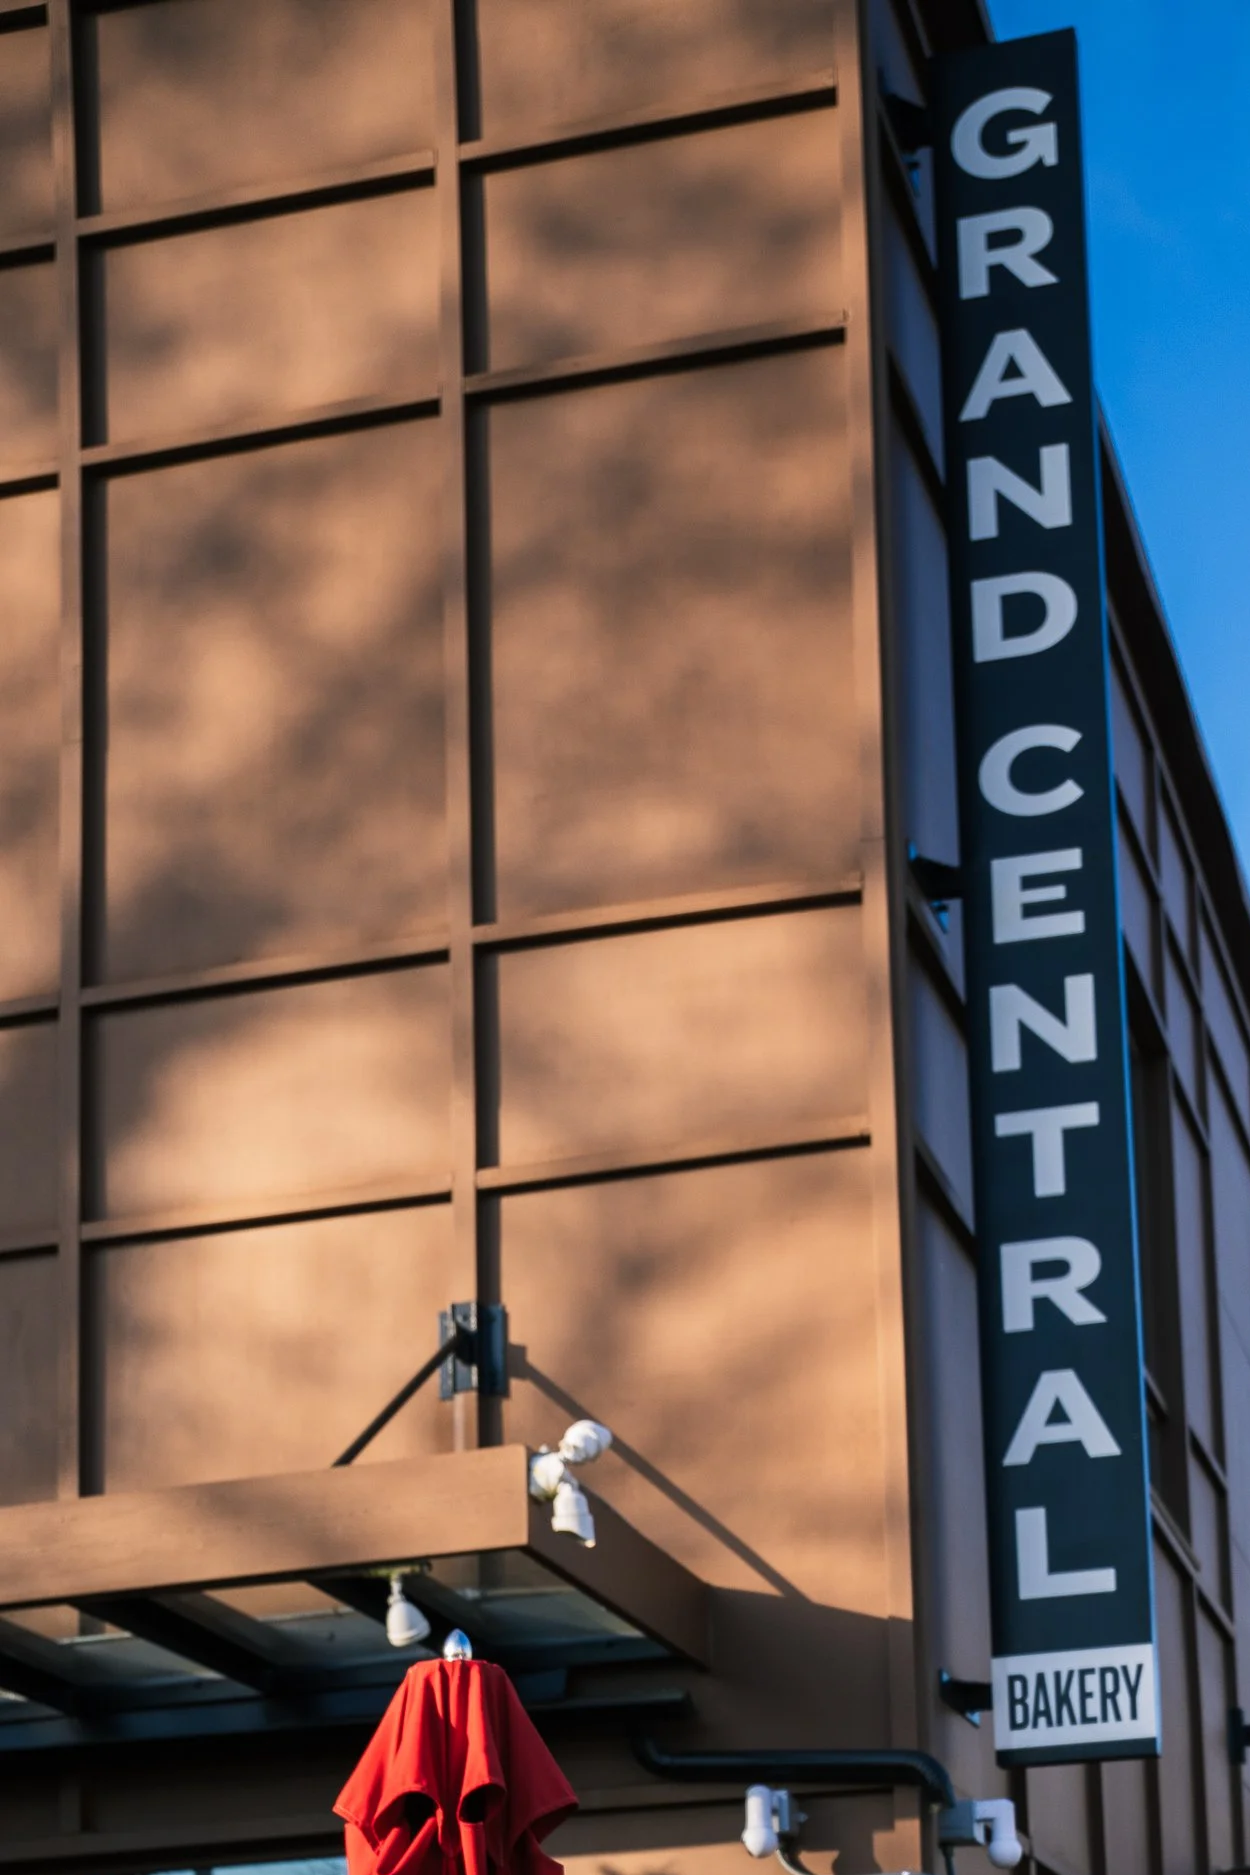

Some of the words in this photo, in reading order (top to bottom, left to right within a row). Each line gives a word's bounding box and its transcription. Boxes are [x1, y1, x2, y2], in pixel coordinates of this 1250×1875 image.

[950, 86, 1078, 663] GRAND
[977, 724, 1122, 1601] CENTRAL
[1007, 1663, 1144, 1732] BAKERY
